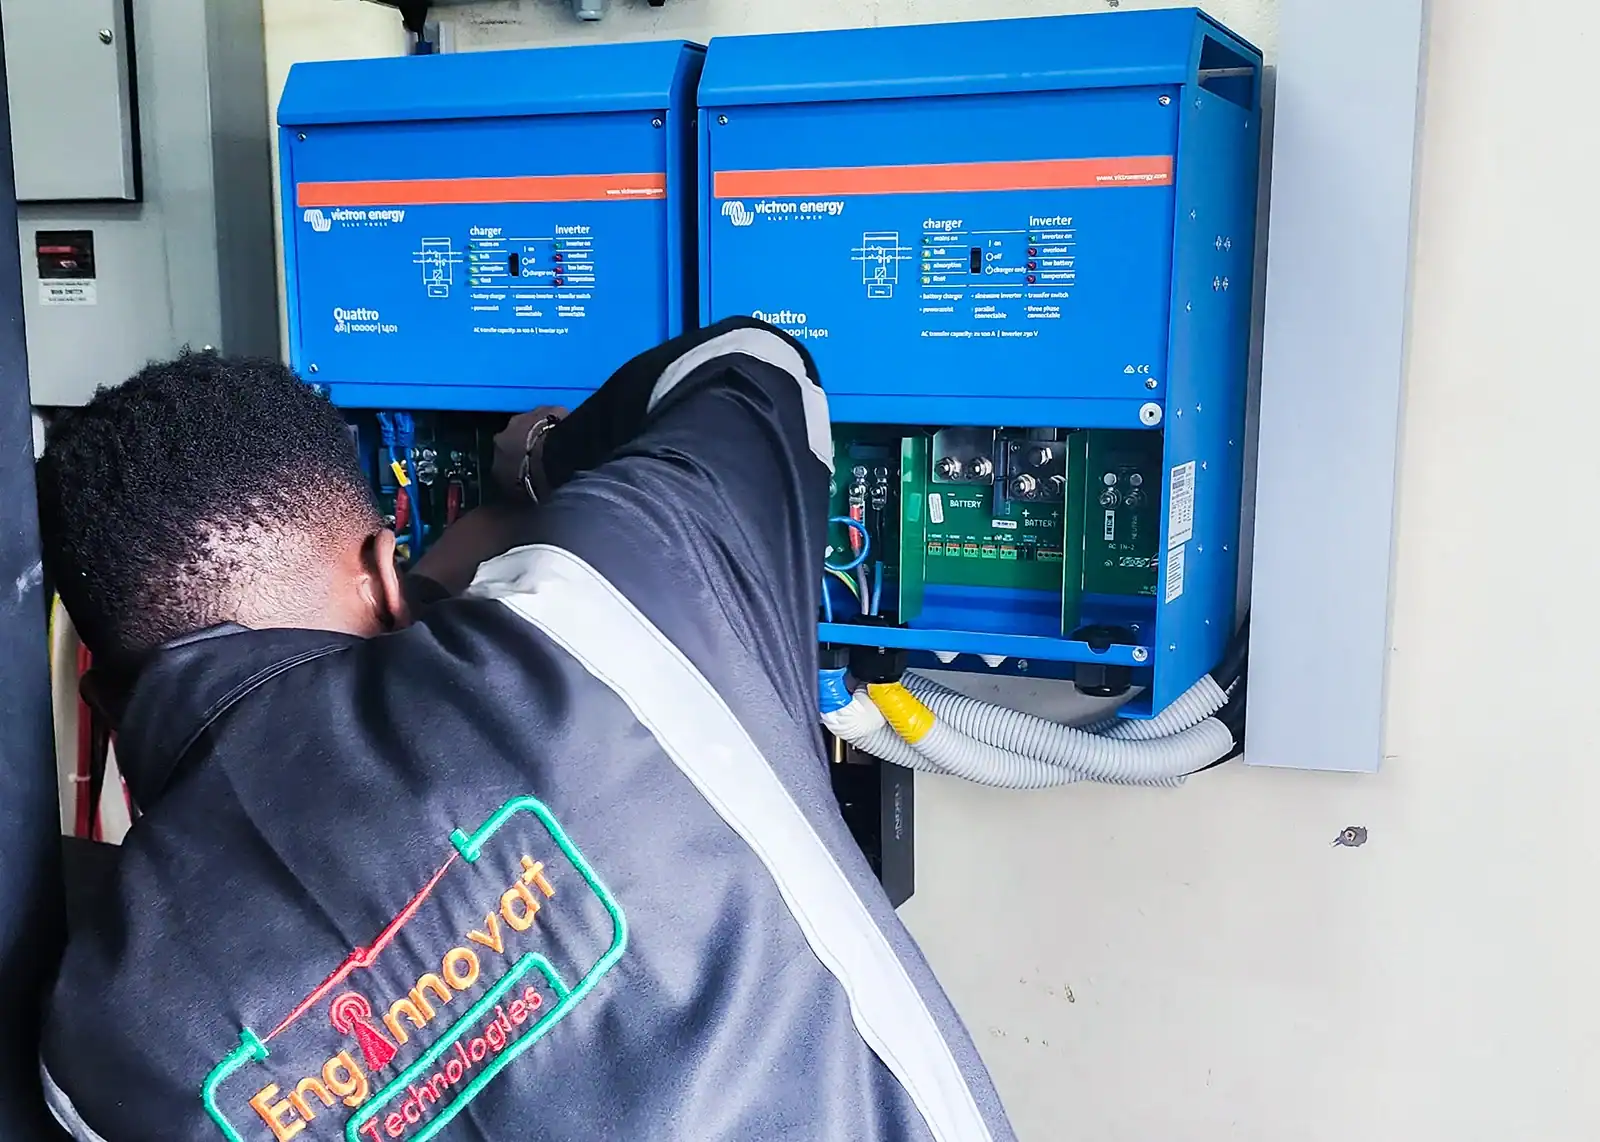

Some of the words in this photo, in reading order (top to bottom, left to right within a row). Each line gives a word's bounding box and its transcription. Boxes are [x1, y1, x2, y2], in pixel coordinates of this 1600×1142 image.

[755, 200, 797, 213] victron
[800, 201, 845, 215] energy
[331, 208, 366, 221] victron
[368, 210, 405, 223] energy
[923, 218, 963, 231] charger
[469, 226, 502, 238] charger
[334, 307, 379, 323] Quattro
[752, 310, 807, 324] Quattro
[950, 499, 982, 509] BATTERY
[1024, 519, 1057, 528] BATTERY
[1108, 542, 1117, 550] AC
[359, 985, 544, 1142] Technologies
